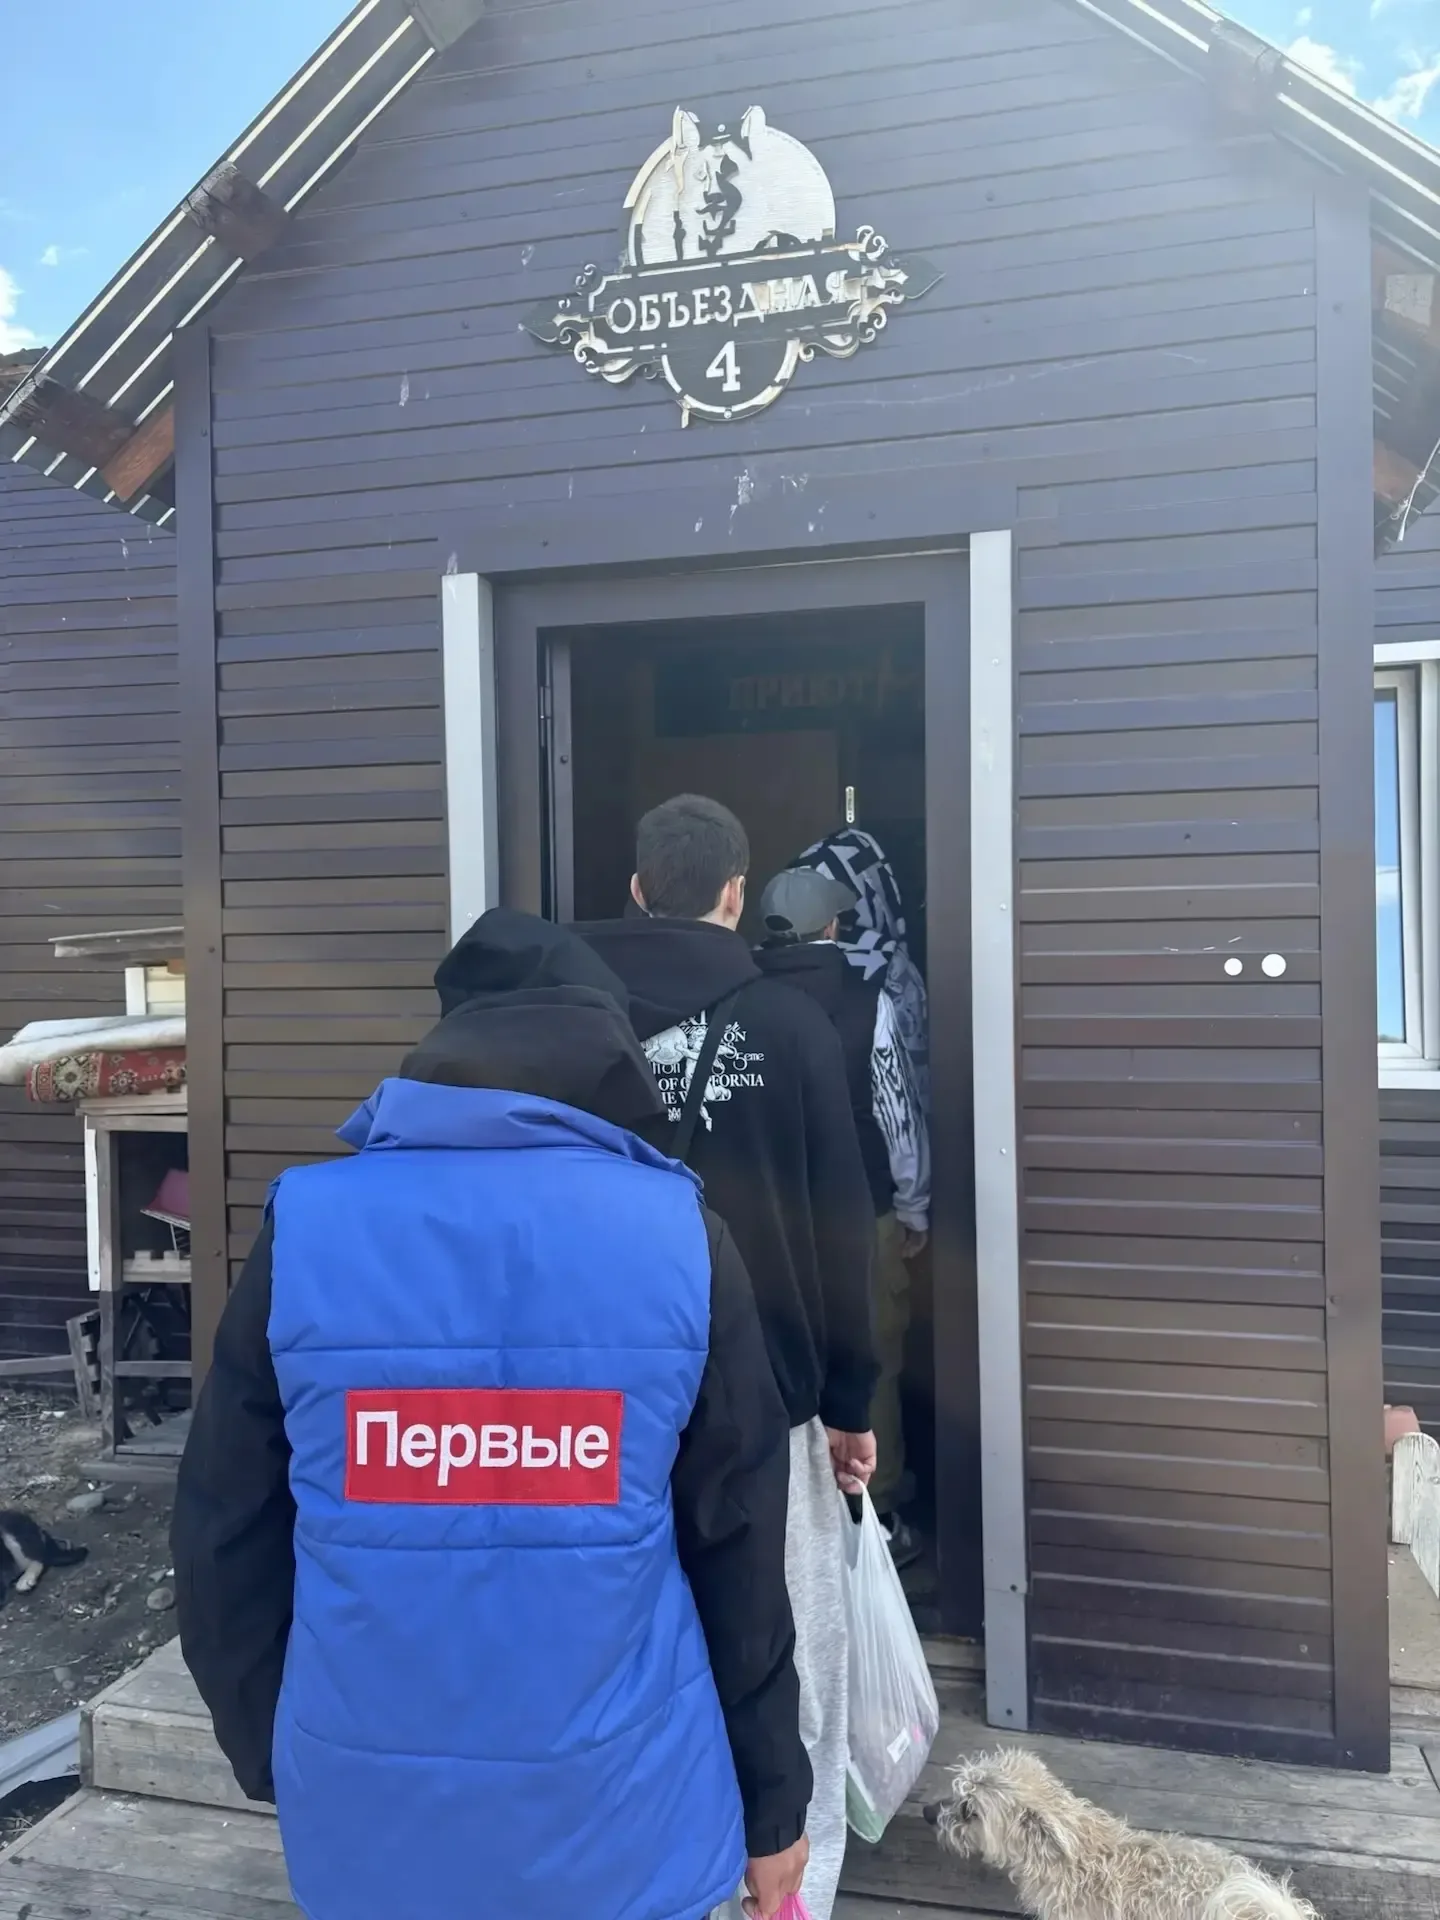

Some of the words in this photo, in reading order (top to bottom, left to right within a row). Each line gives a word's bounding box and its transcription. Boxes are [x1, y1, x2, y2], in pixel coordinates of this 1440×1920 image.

[607, 269, 849, 334] ОБЪЕЗДНАЯ
[705, 340, 741, 392] 4
[728, 673, 865, 711] ПРИЮТ
[657, 1077, 679, 1092] OF
[355, 1410, 610, 1487] Первые
